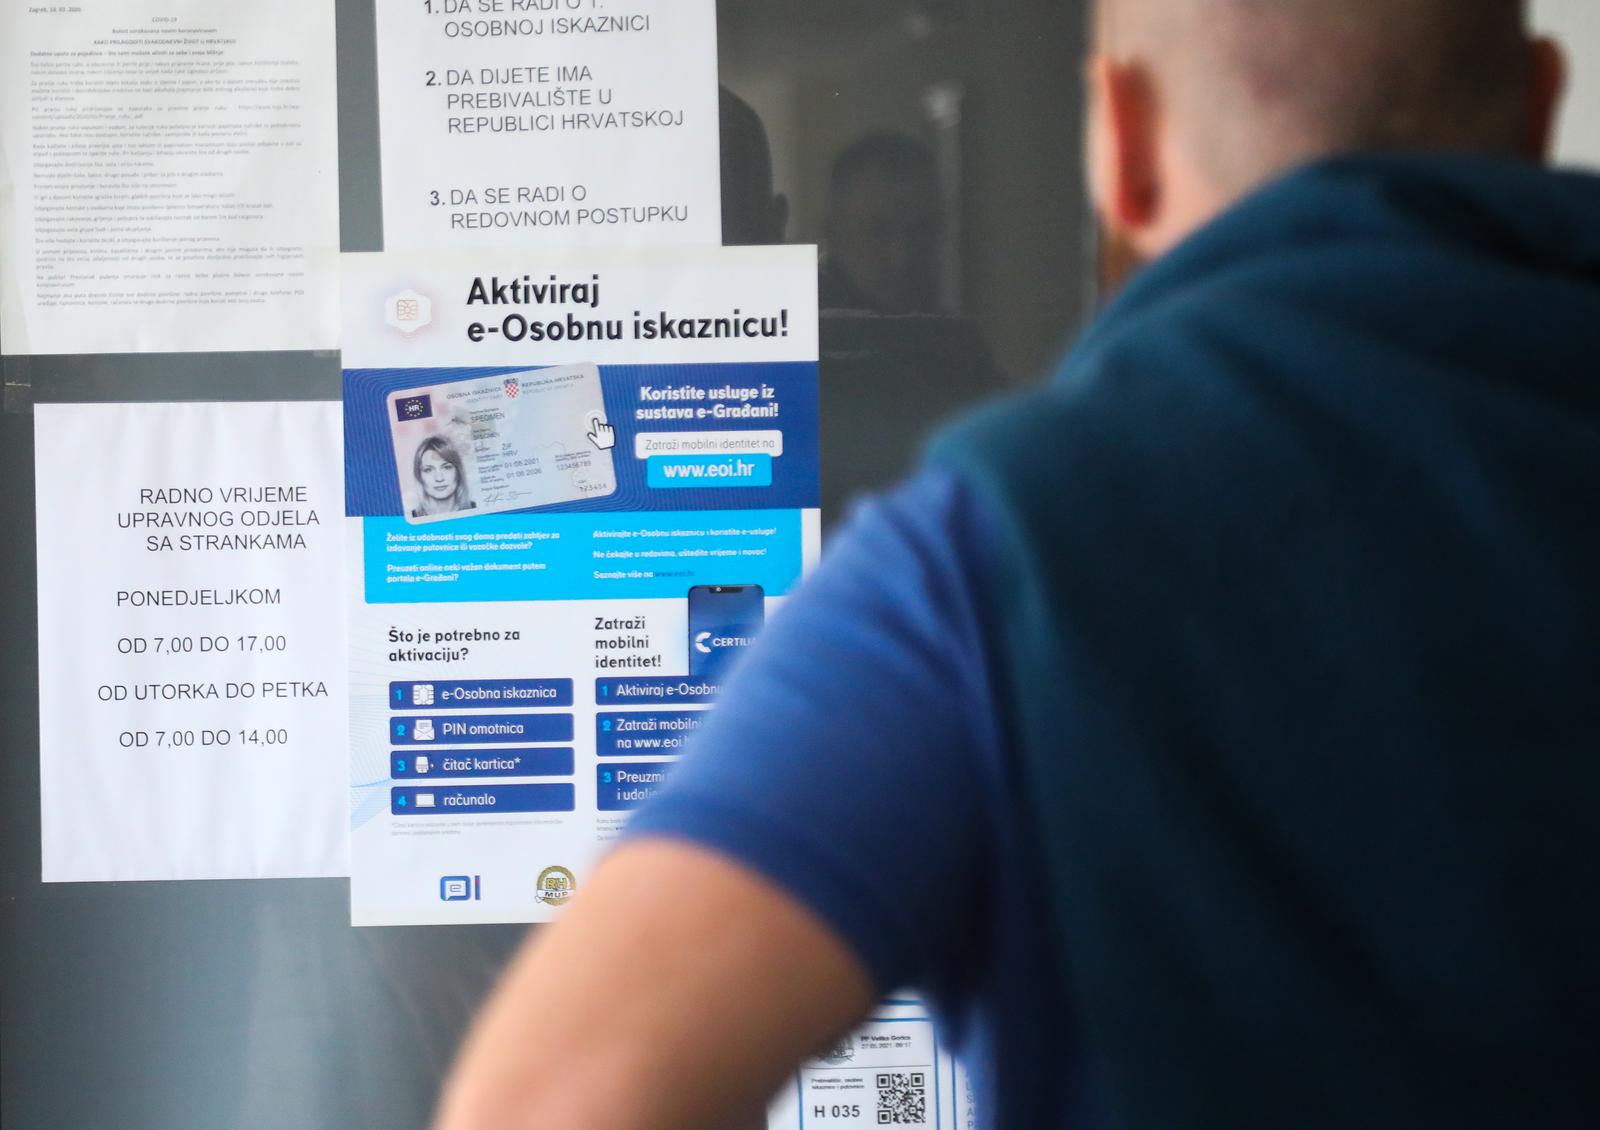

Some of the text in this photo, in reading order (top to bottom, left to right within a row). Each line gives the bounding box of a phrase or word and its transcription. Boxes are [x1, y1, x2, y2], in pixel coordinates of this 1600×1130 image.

[445, 15, 649, 38] OSOBNOJ ISKAZNICI
[426, 65, 592, 86] 2. DA DIJETE IMA
[447, 87, 612, 110] PREBIVALIŠTE U
[448, 110, 684, 133] REPUBLICI HRVATSKOJ
[430, 185, 586, 206] 3. DA SE RADI O
[451, 206, 688, 229] REDOVNOM POSTUPKU
[467, 274, 599, 307] Aktiviraj
[467, 309, 788, 342] e-Osobnu iskaznicu!
[641, 385, 774, 402] Koristite usluge iz
[409, 404, 419, 412] HR
[636, 404, 779, 419] sustava e-Građani!
[645, 437, 775, 451] Zatraži mobilni identitet na
[663, 461, 755, 478] www.eoi.hr
[140, 486, 307, 504] RADNO VRIJEME
[118, 510, 319, 528] UPRAVNOG ODJELA
[386, 532, 408, 542] Želite
[455, 534, 472, 542] svog
[496, 533, 522, 542] predati
[592, 530, 631, 539] Aktivirajte
[671, 529, 705, 537] iskaznicu
[710, 528, 740, 536] koristite
[742, 528, 777, 536] e-usluge!
[147, 534, 306, 551] SA STRANKAMA
[387, 544, 422, 552] izdavanje
[423, 543, 458, 552] putovnice
[460, 543, 468, 551] ili
[500, 542, 532, 550] dozvole?
[606, 550, 633, 559] čekajte
[710, 548, 737, 557] vrijeme
[387, 564, 418, 572] Preuzeti
[484, 562, 521, 570] dokument
[387, 575, 414, 583] portala
[593, 571, 626, 579] Saznajte
[628, 570, 643, 578] više
[117, 589, 281, 606] PONEDJELJKOM
[595, 617, 646, 631] Zatraži
[389, 626, 520, 644] Što je potrebno za
[118, 636, 286, 656] OD 7,00 DO 17,00
[595, 636, 649, 649] mobilni
[389, 648, 468, 662] aktivaciju?
[595, 654, 661, 668] identitet!
[98, 682, 328, 701] OD UTORKA DO PETKA
[395, 689, 402, 700] 1
[442, 686, 557, 700] e-Osobna iskaznica
[602, 686, 608, 696] 1
[616, 684, 664, 698] Aktiviraj
[396, 725, 406, 736] 2
[442, 722, 524, 735] PIN omotnica
[602, 721, 611, 731] 2
[616, 718, 657, 731] Zatraži
[119, 728, 287, 749] OD 7,00 DO 14,00
[617, 738, 631, 748] na
[397, 761, 406, 771] 3
[442, 758, 472, 771] čitač
[603, 772, 612, 783] 3
[397, 796, 407, 807] 4
[444, 792, 496, 806] računalo
[815, 1105, 860, 1117] H 035
